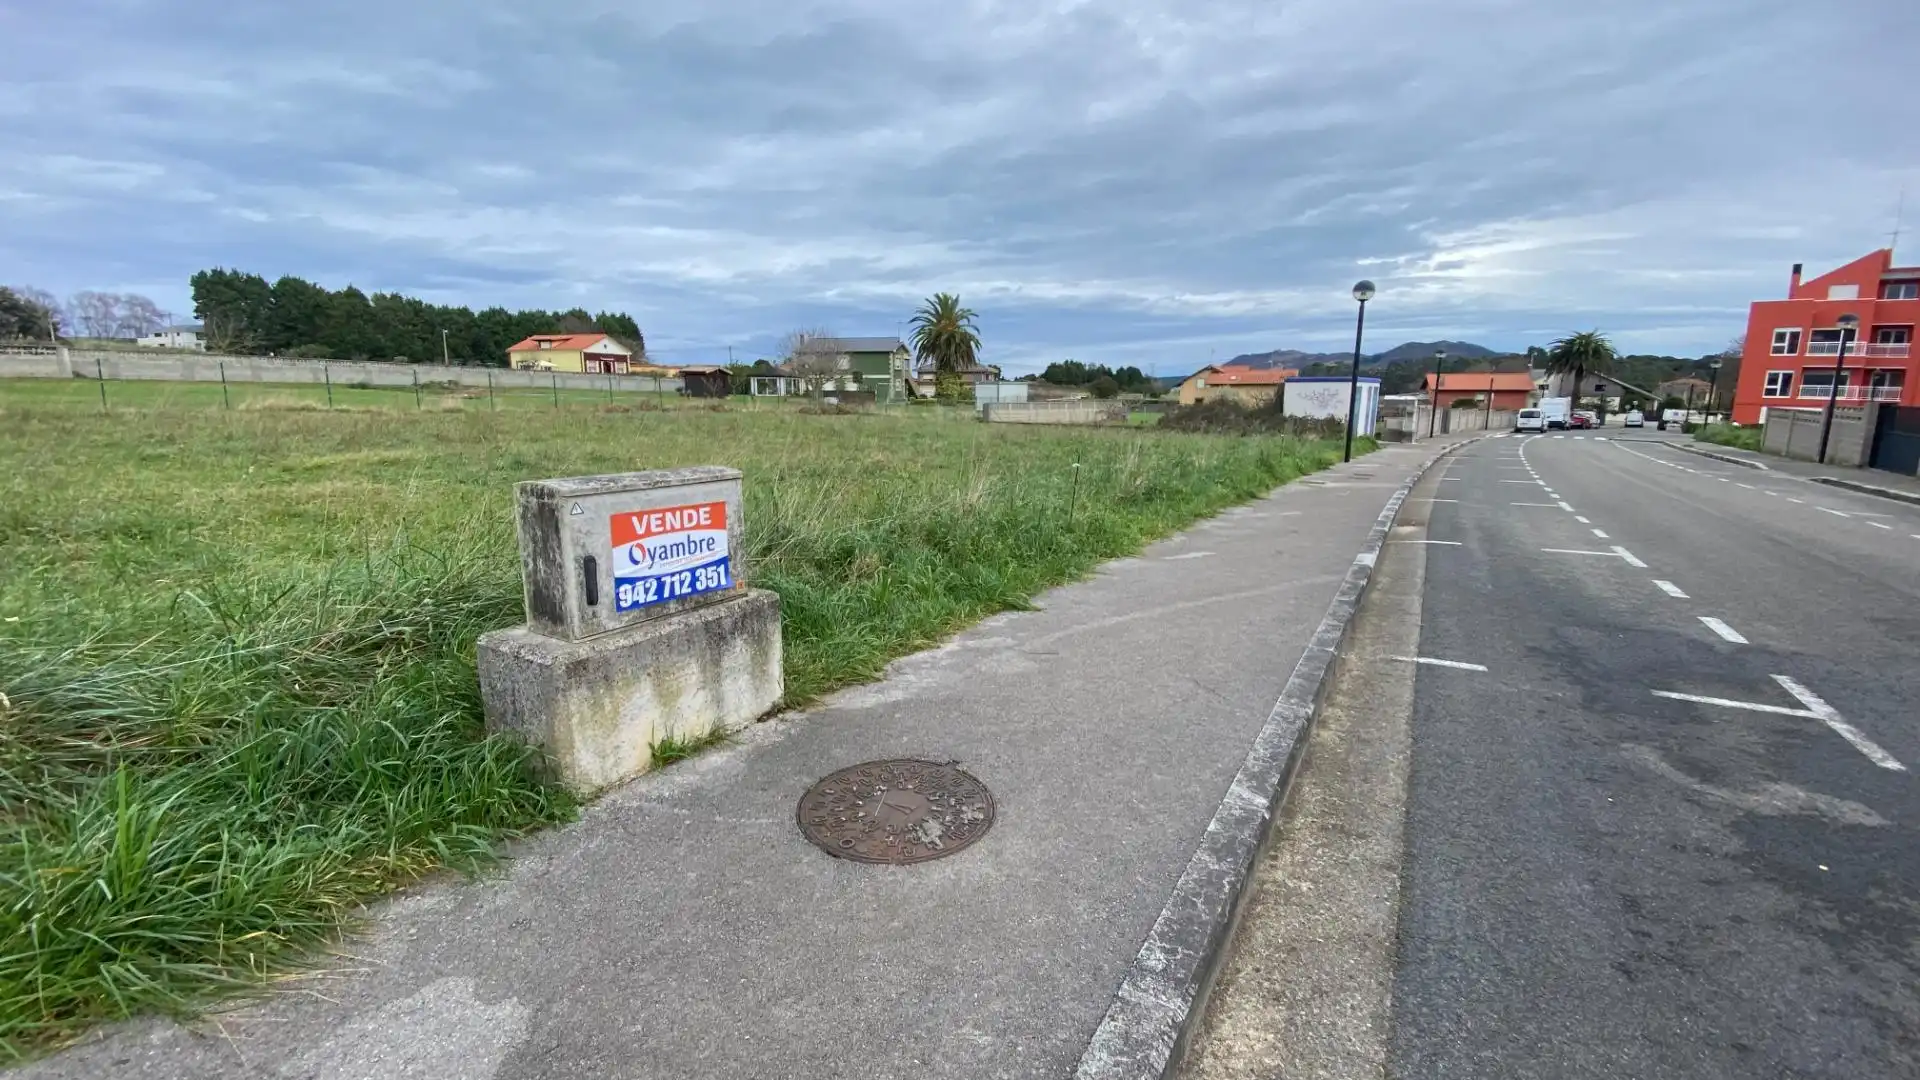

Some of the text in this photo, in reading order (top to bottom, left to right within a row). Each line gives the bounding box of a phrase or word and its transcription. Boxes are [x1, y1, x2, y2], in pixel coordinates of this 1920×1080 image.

[631, 507, 712, 535] VENDE
[628, 534, 716, 570] Oyambre
[618, 564, 727, 608] 942 712 351
